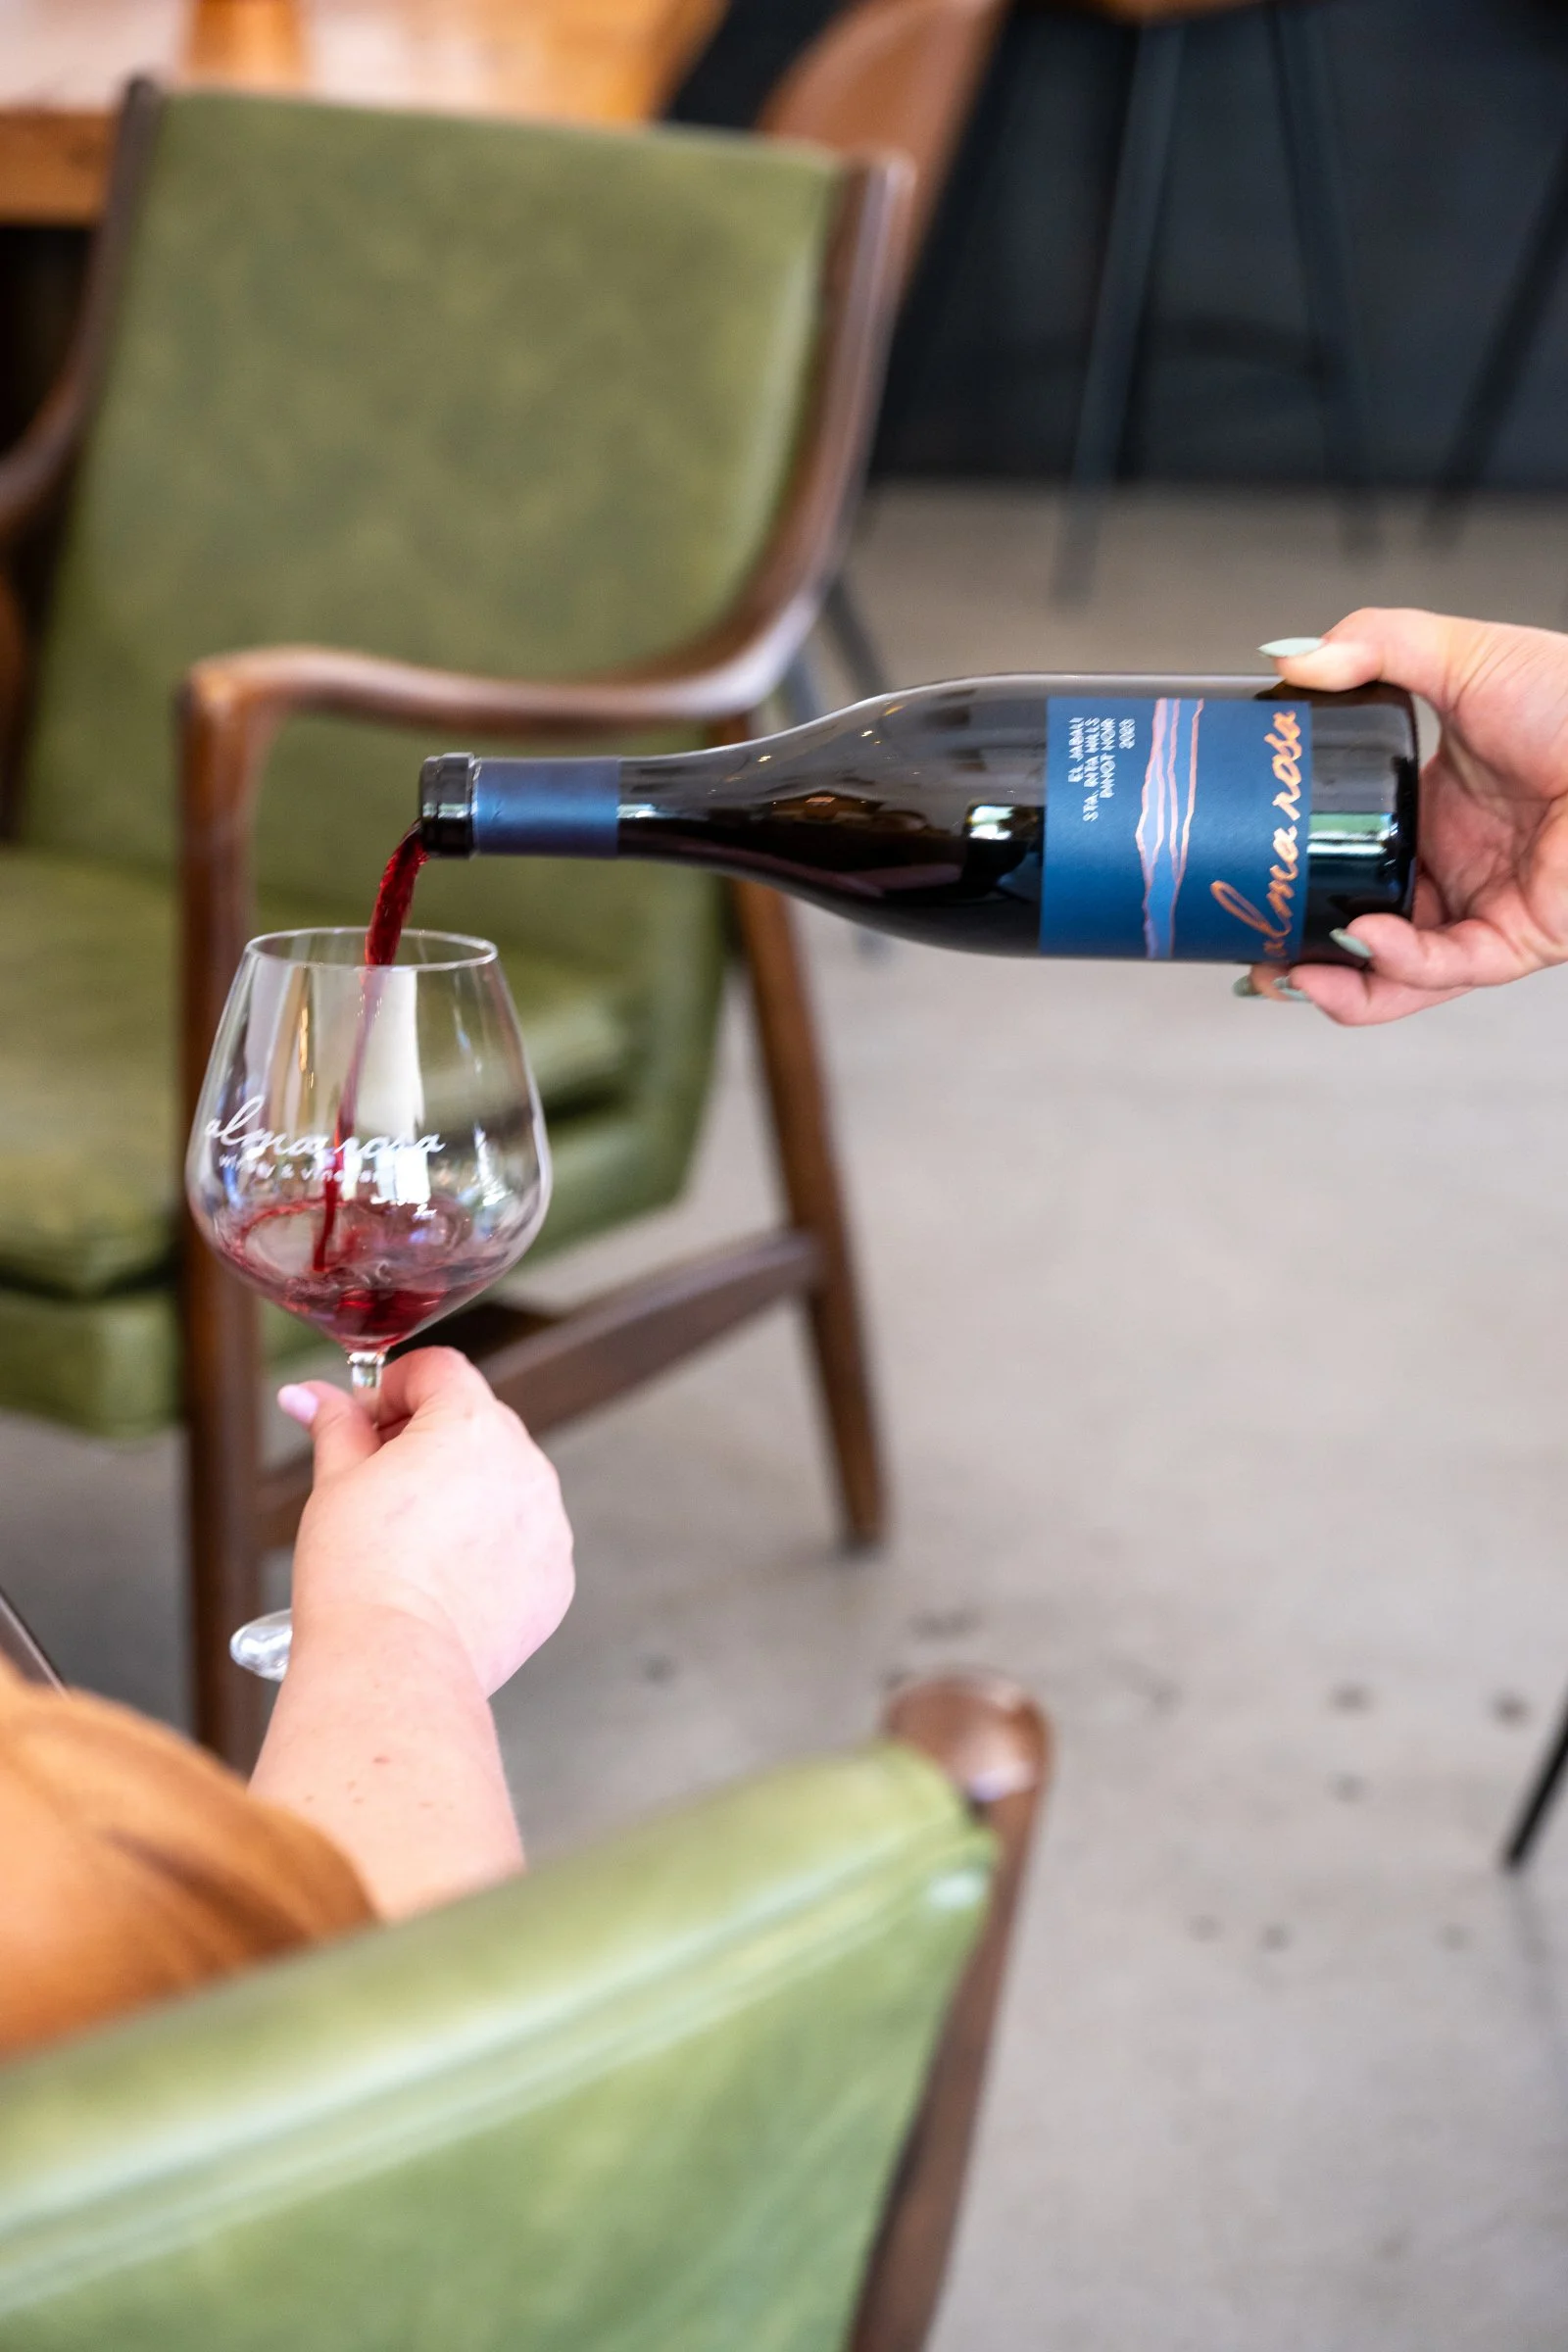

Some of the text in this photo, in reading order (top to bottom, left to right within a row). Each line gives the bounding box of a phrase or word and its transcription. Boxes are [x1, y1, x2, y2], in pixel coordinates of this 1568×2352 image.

[1067, 763, 1084, 783] EL
[1082, 717, 1100, 822] STA. RITA HILLS
[1100, 718, 1115, 799] PINOT NOIR
[1264, 710, 1302, 821] rosa
[203, 1095, 329, 1156] alma
